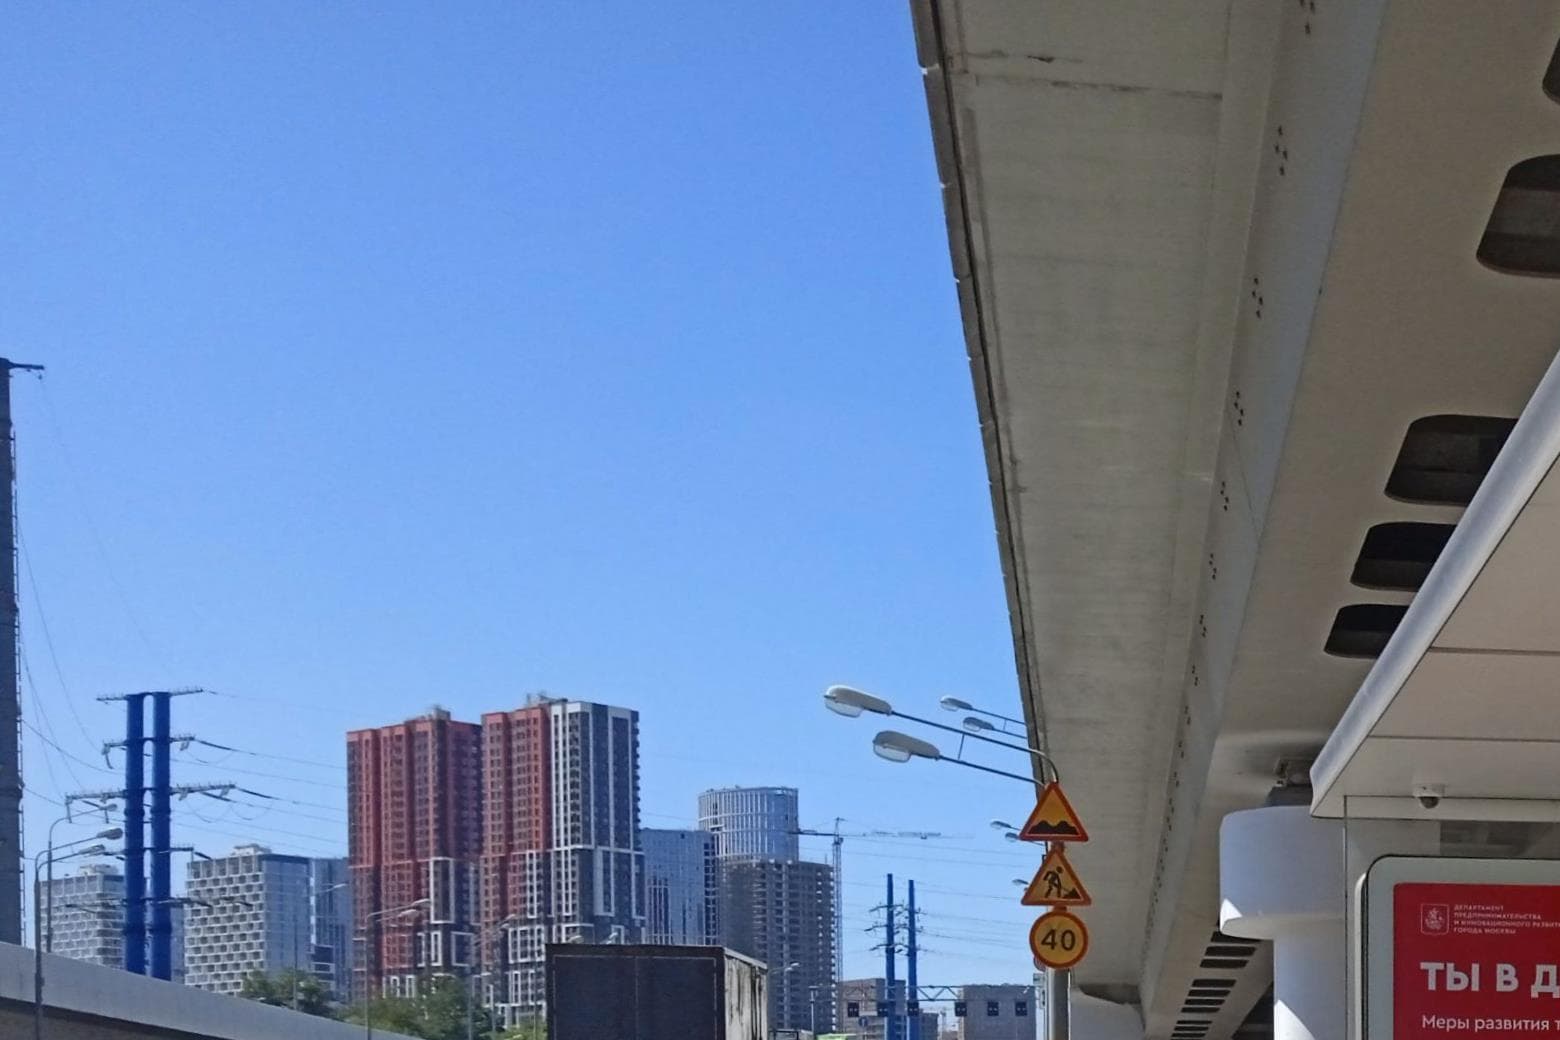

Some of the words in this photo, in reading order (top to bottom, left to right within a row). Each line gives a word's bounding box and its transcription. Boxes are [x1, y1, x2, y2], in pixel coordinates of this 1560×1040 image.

[1041, 929, 1076, 950] 40
[1420, 962, 1480, 992] ТЫ
[1496, 963, 1519, 992] В
[1421, 1014, 1470, 1032] Меры
[1474, 1017, 1550, 1032] развития
